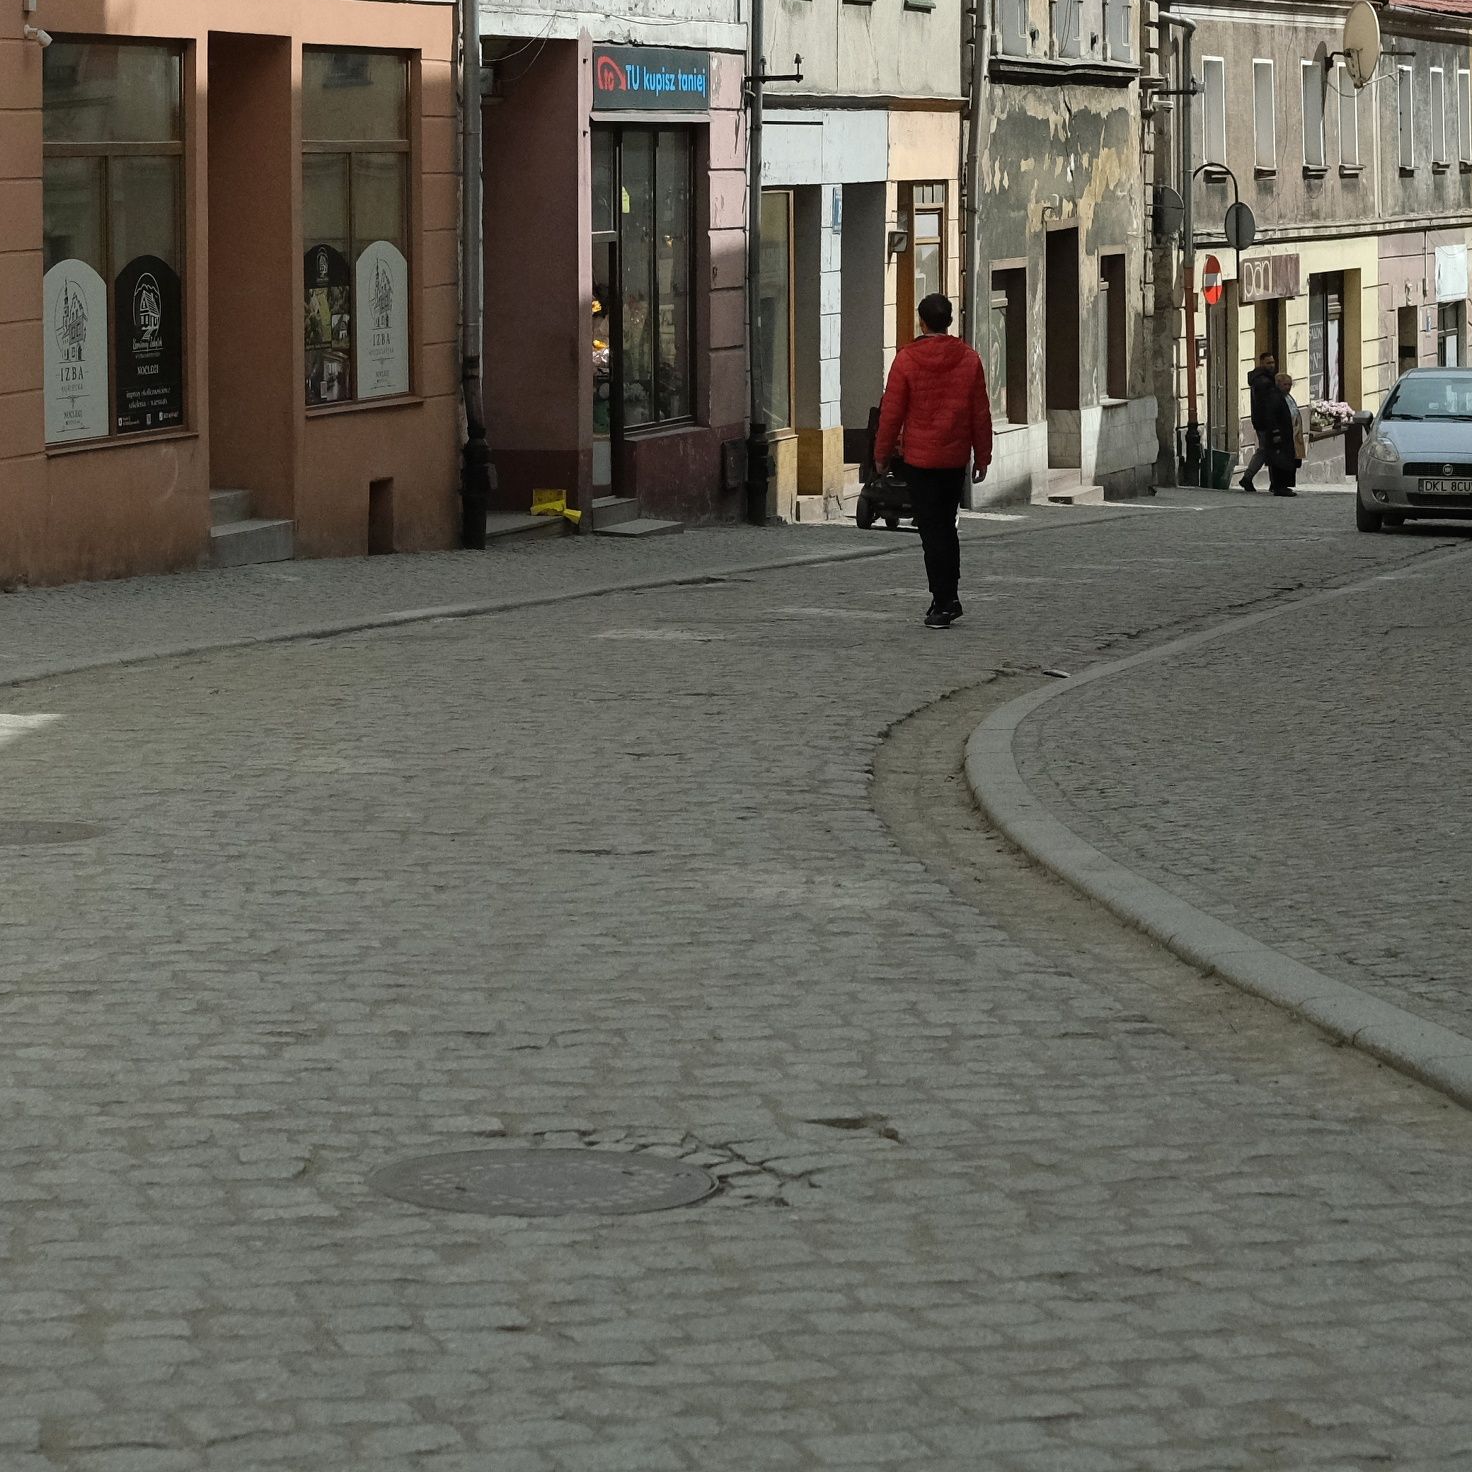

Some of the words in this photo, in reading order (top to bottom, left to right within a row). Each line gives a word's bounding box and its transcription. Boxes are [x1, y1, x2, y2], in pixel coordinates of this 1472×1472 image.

[625, 64, 640, 90] TU
[643, 66, 676, 96] kupisz
[677, 68, 706, 98] taniej
[372, 332, 391, 347] IZBA
[60, 366, 84, 382] IZBA
[1426, 480, 1447, 492] DKL
